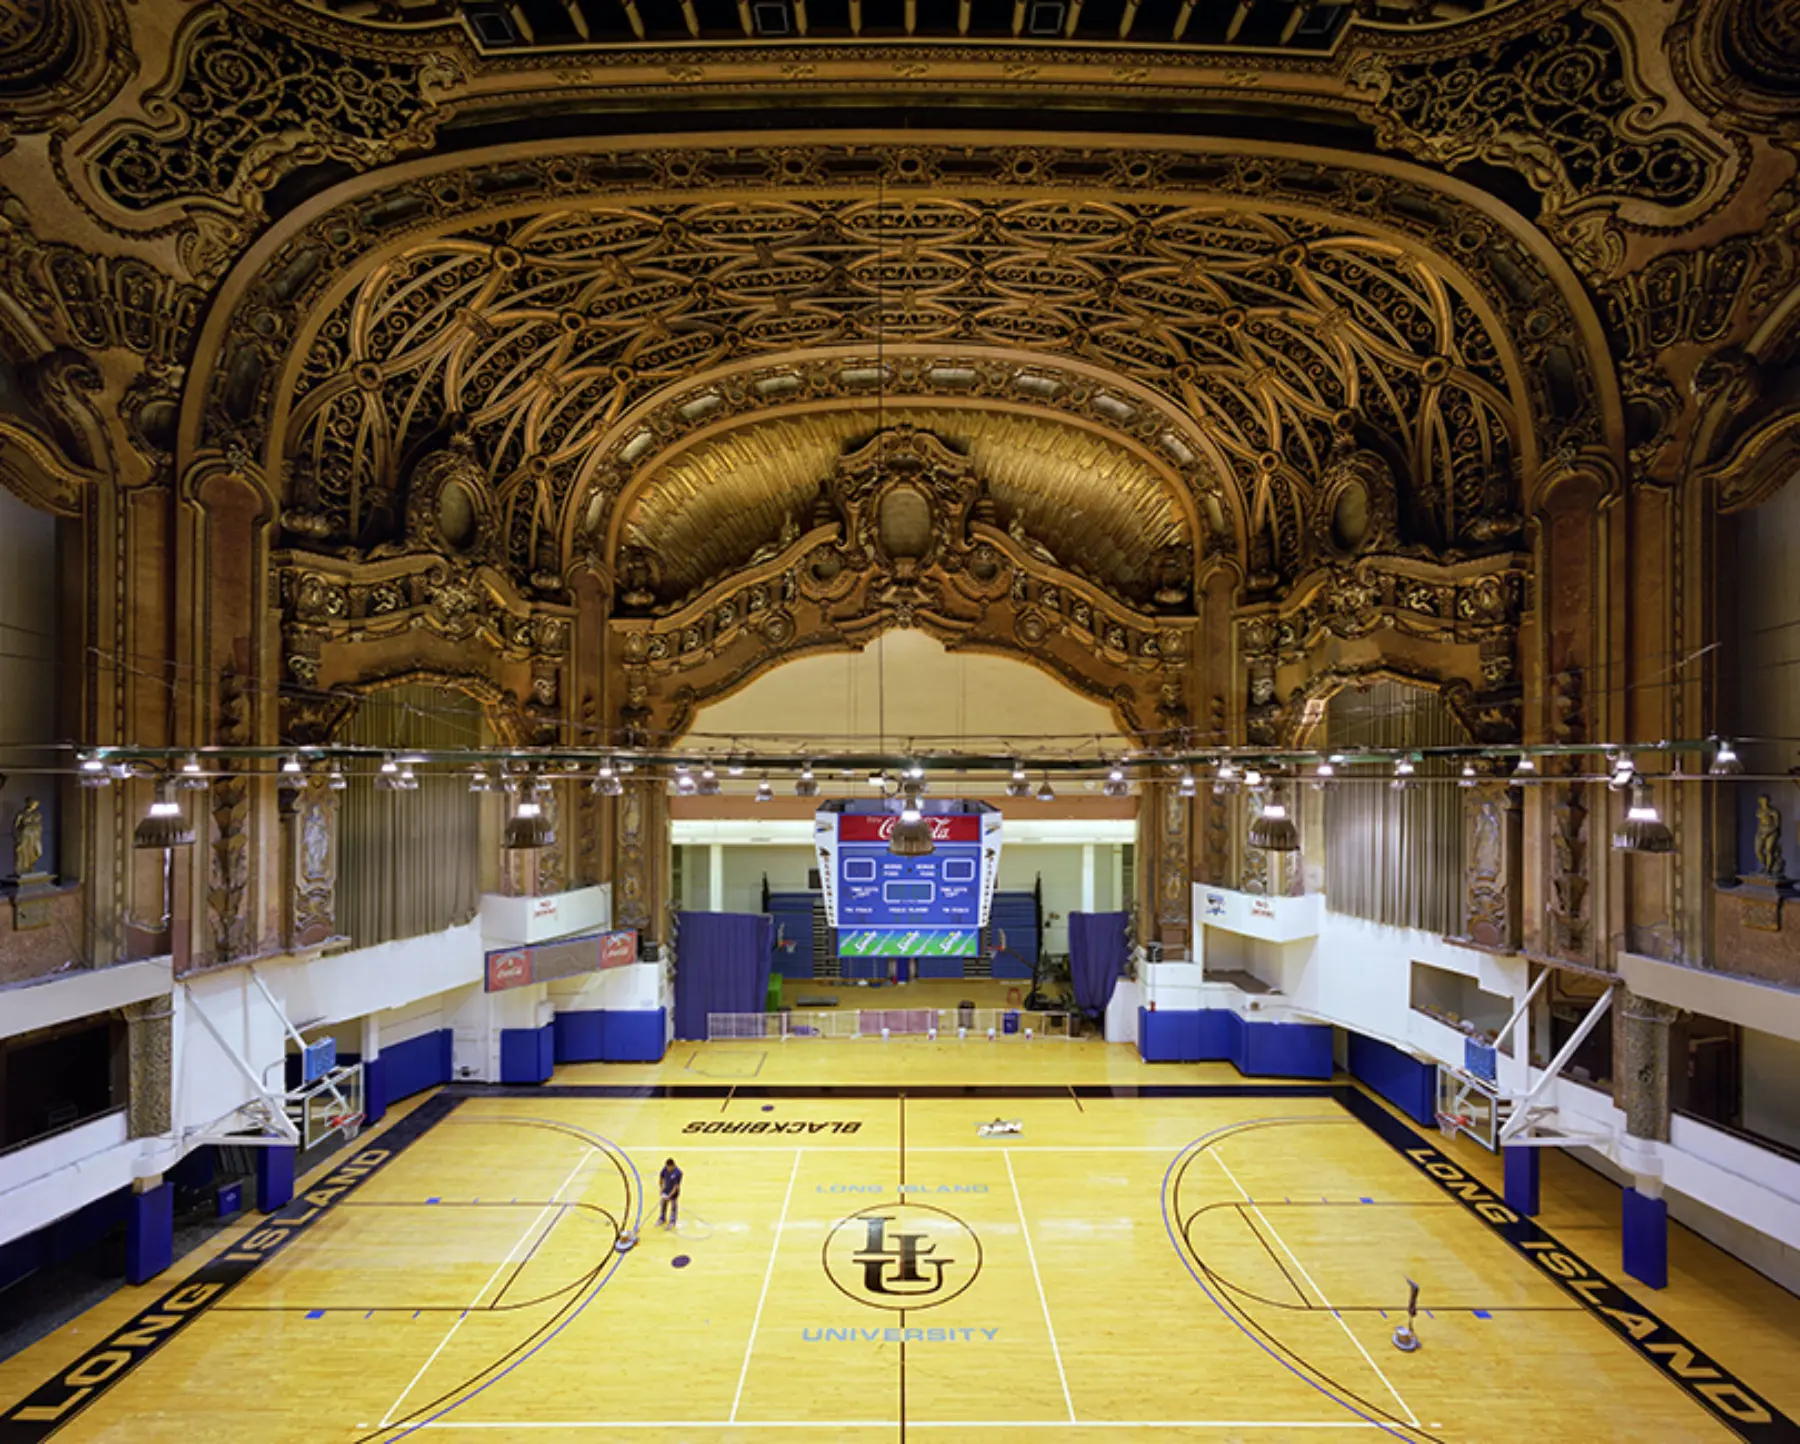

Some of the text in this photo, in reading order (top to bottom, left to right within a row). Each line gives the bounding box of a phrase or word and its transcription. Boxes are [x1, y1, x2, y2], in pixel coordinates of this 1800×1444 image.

[682, 1121, 862, 1134] BLACKBIRDS
[817, 1184, 989, 1194] LONG ISLAND
[11, 1149, 391, 1420] LONG ISLAND
[1405, 1148, 1773, 1423] LONG ISLAND
[802, 1327, 999, 1342] UNIVERSITY
